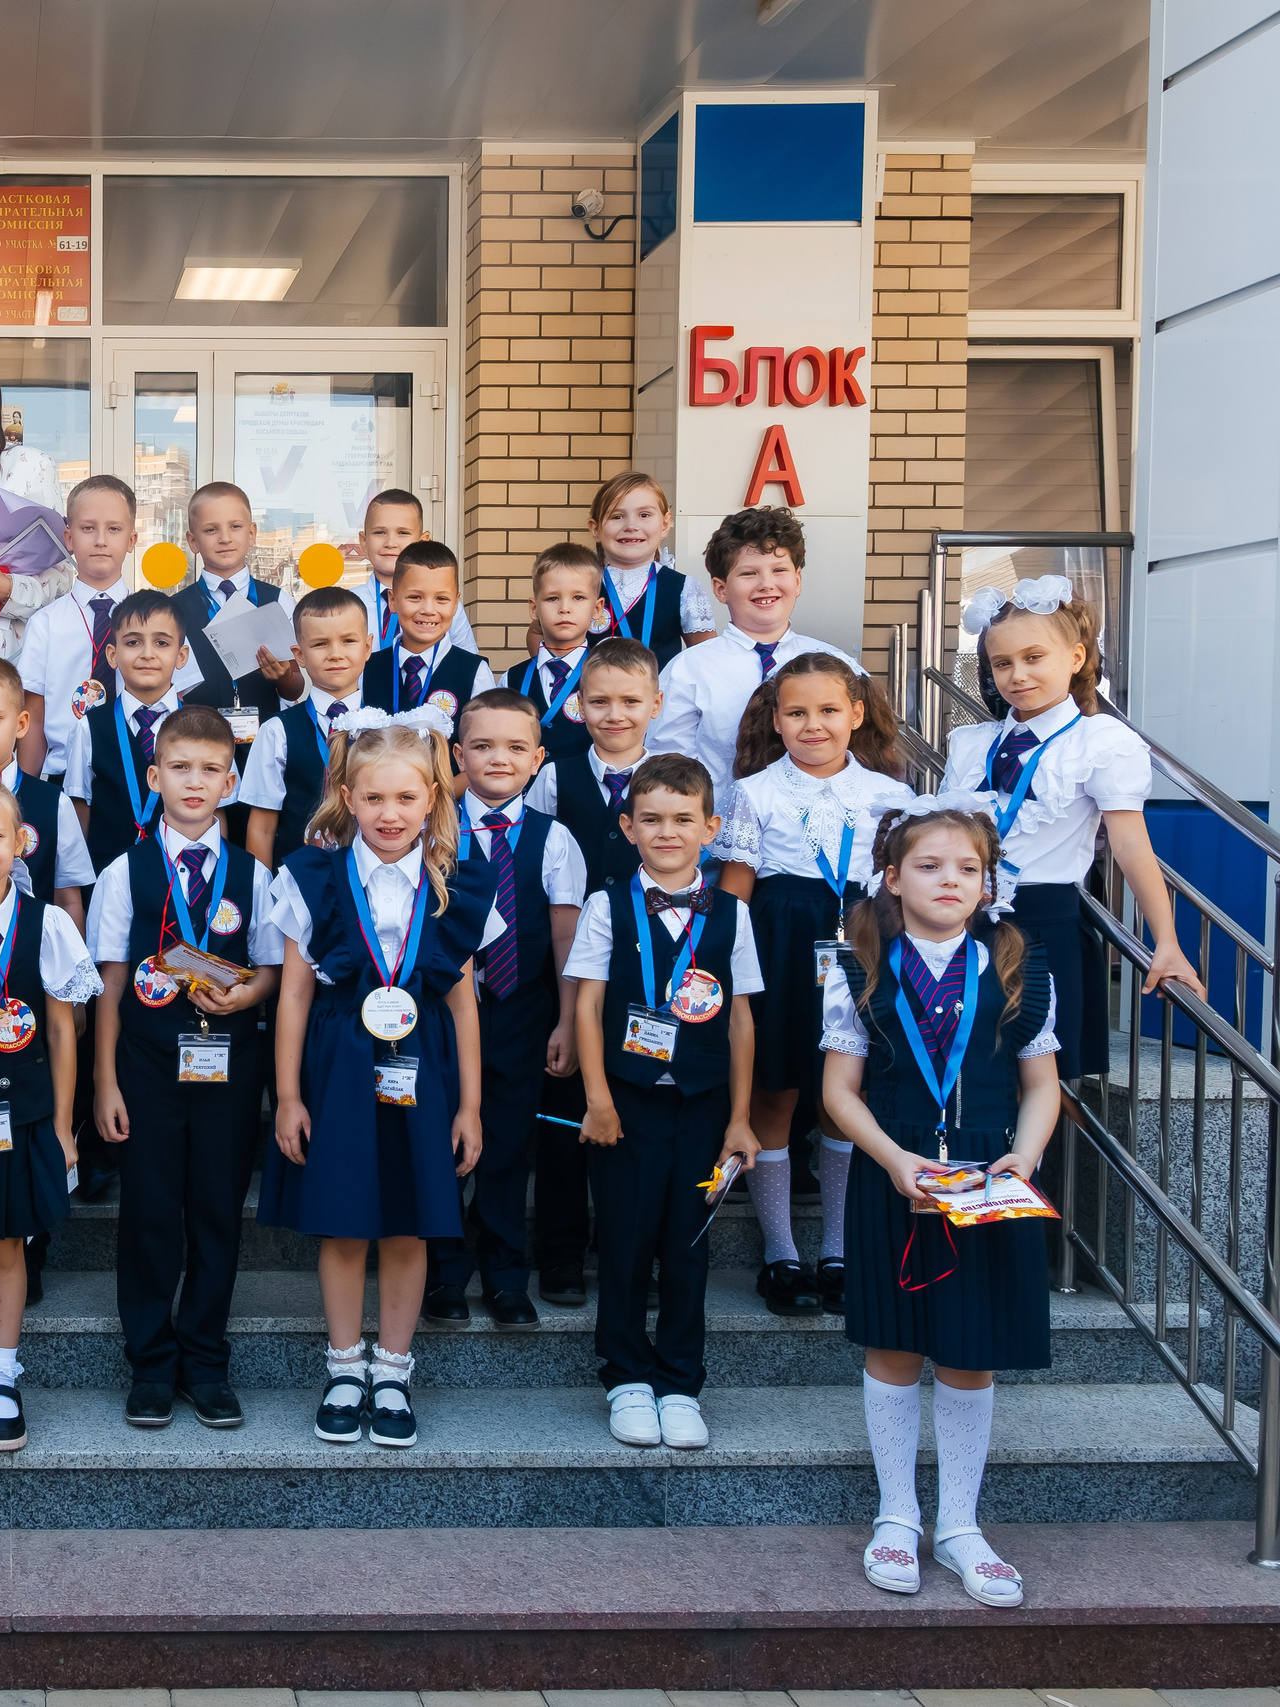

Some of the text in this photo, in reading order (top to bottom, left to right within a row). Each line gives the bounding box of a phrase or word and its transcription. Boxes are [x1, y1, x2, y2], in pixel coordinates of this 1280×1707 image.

[5, 239, 43, 249] УЧАСТКА
[59, 240, 88, 250] 61-19
[689, 325, 867, 408] Блок
[743, 424, 806, 508] А
